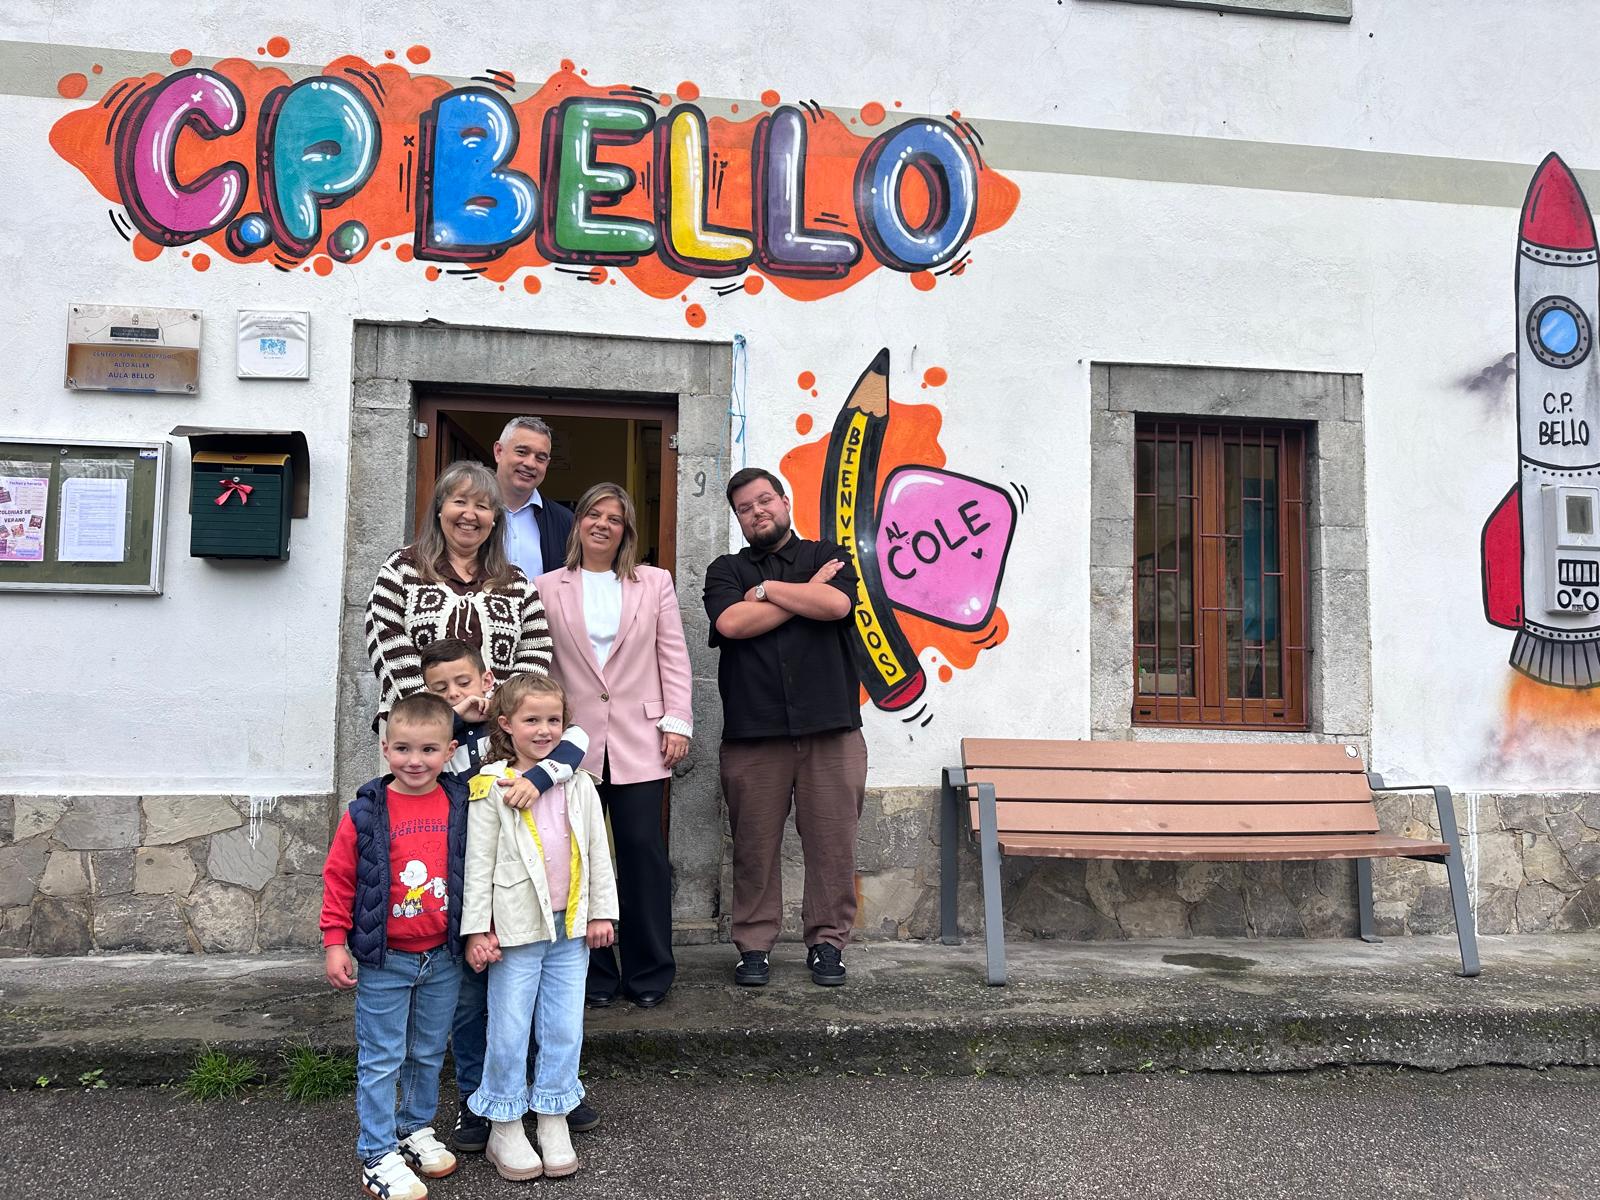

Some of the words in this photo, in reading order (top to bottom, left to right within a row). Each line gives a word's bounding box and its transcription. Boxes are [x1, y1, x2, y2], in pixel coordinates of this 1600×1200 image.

[114, 67, 382, 263] C.P.
[414, 86, 978, 279] BELLO
[1543, 392, 1573, 414] C.P.
[1539, 419, 1589, 446] BELLO
[692, 471, 706, 497] 9
[885, 521, 909, 543] AL
[887, 499, 991, 579] COLE
[839, 427, 898, 677] BIENVEDOS
[391, 824, 448, 840] SCRITCHE
